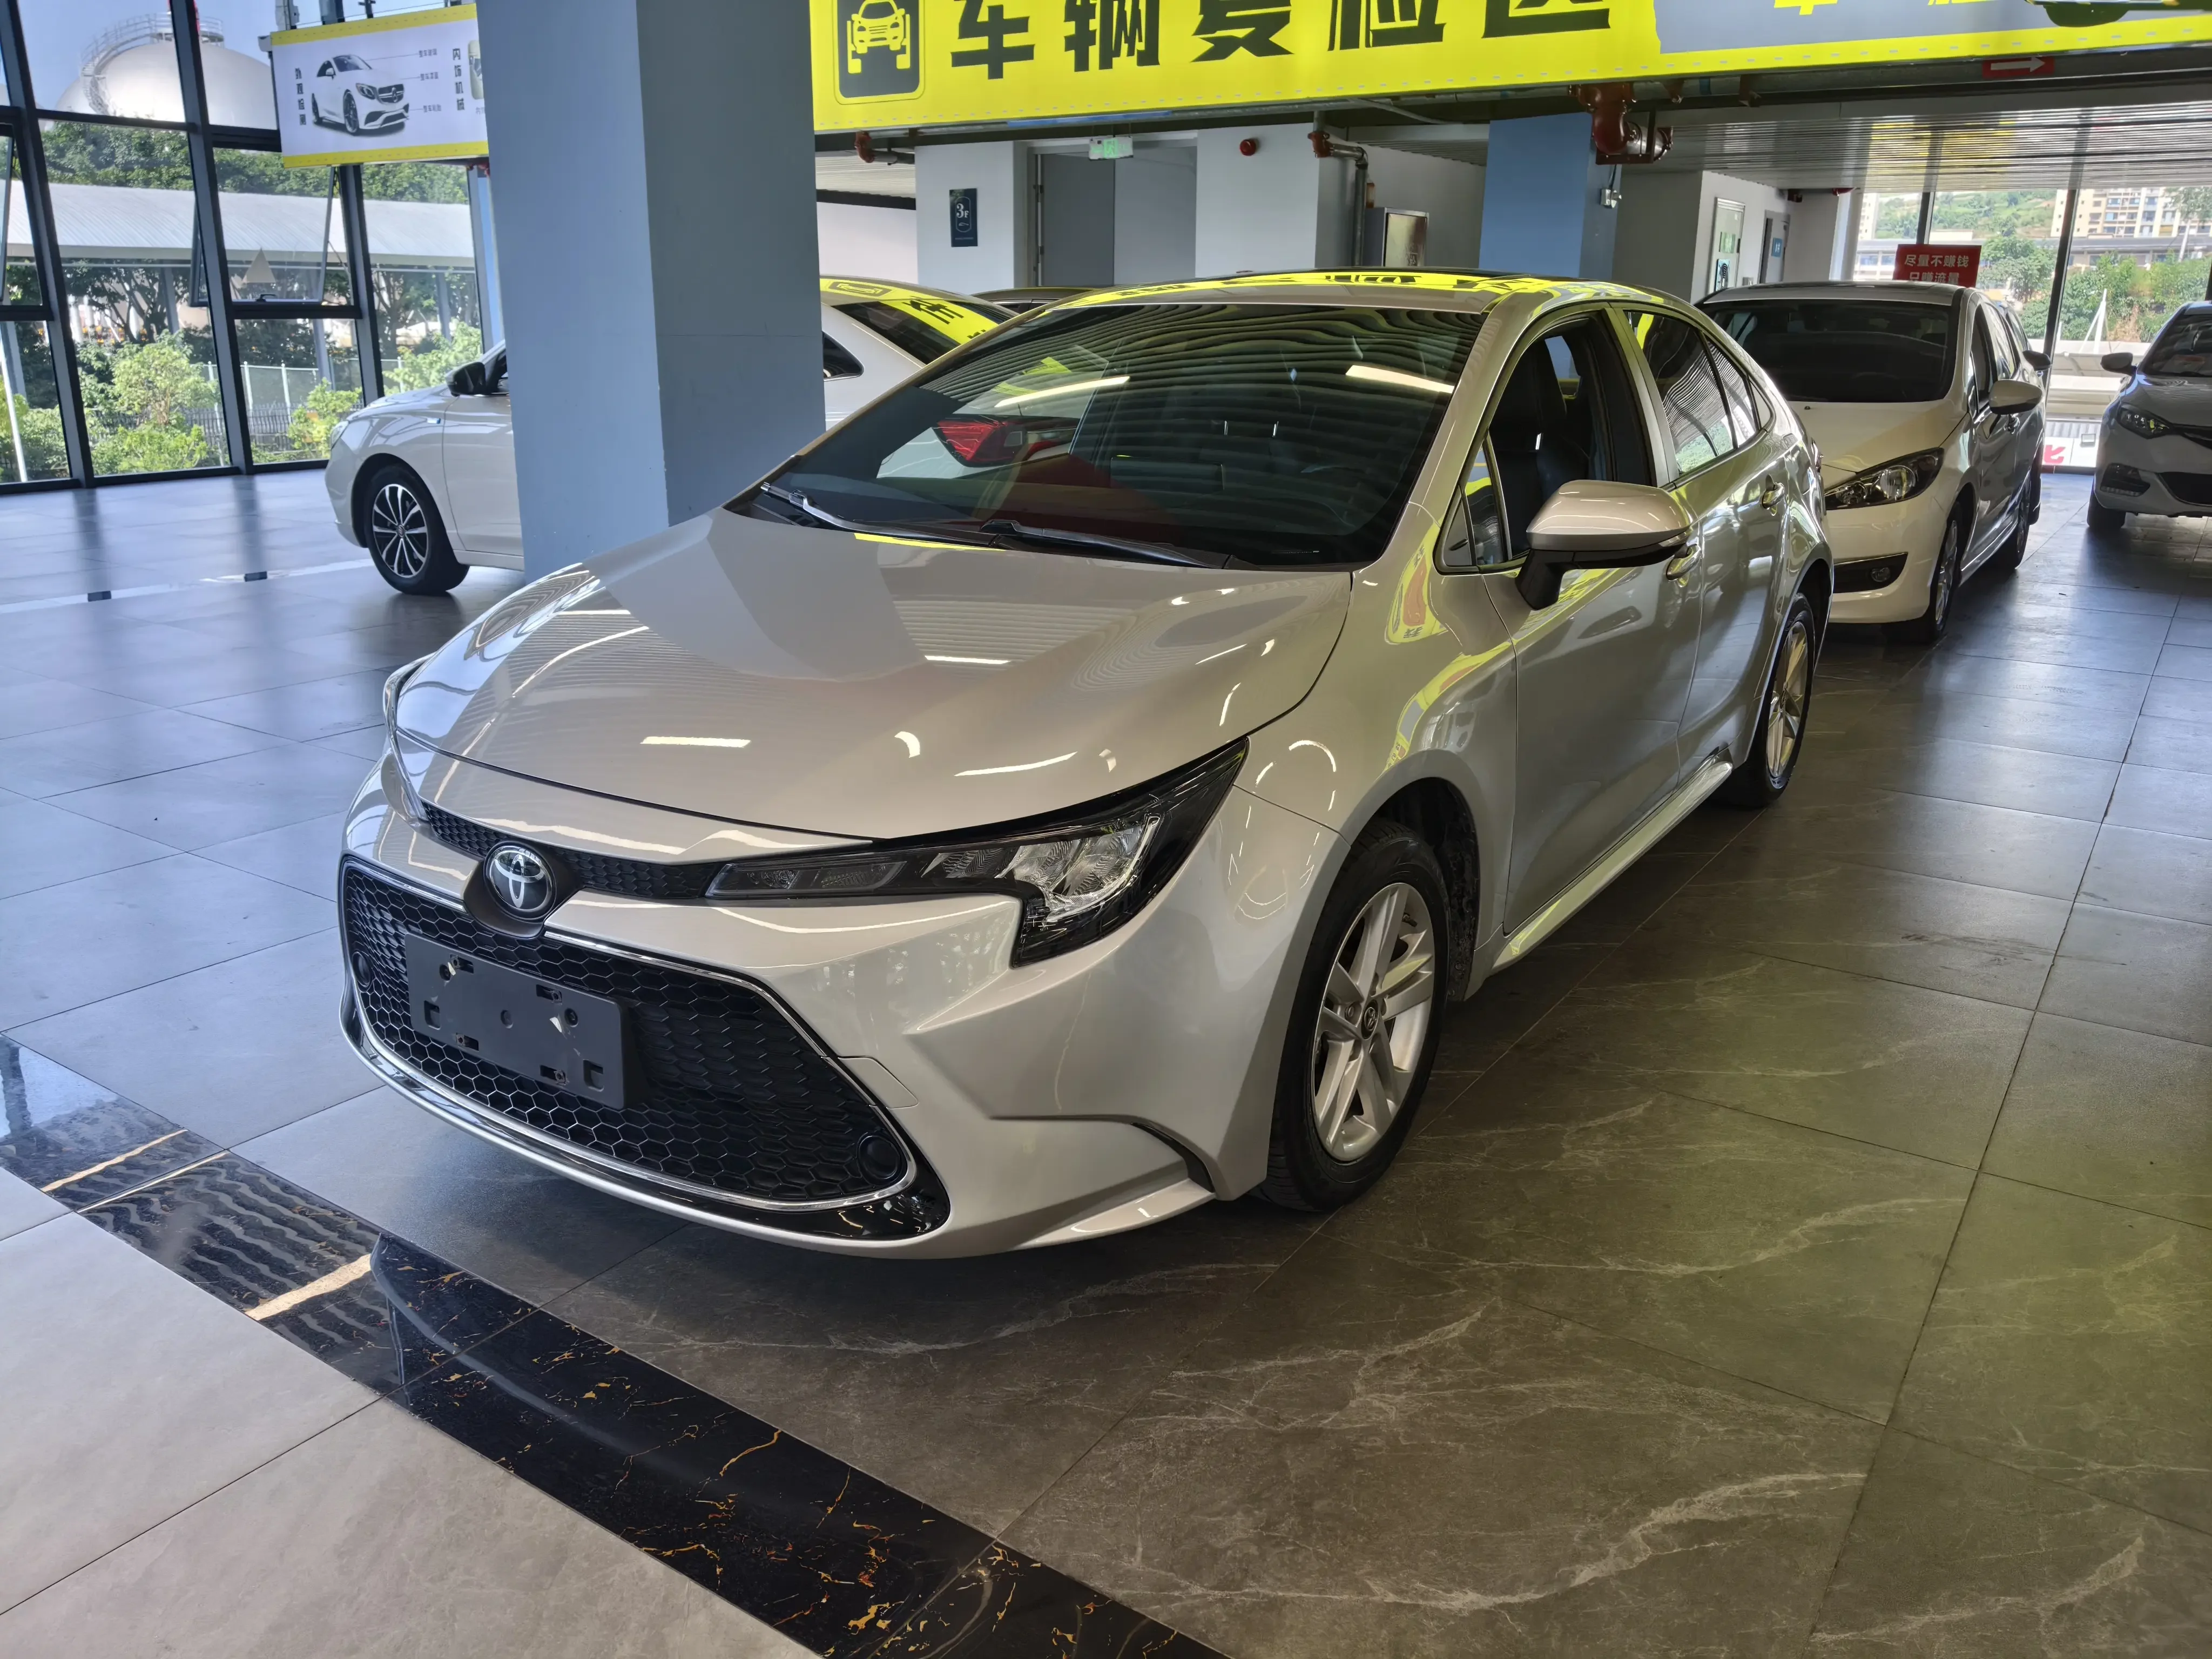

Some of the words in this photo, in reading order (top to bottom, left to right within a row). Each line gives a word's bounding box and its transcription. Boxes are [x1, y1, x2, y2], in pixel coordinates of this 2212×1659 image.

[956, 203, 969, 218] 3F
[1904, 254, 1970, 268] 尽量不赚钱
